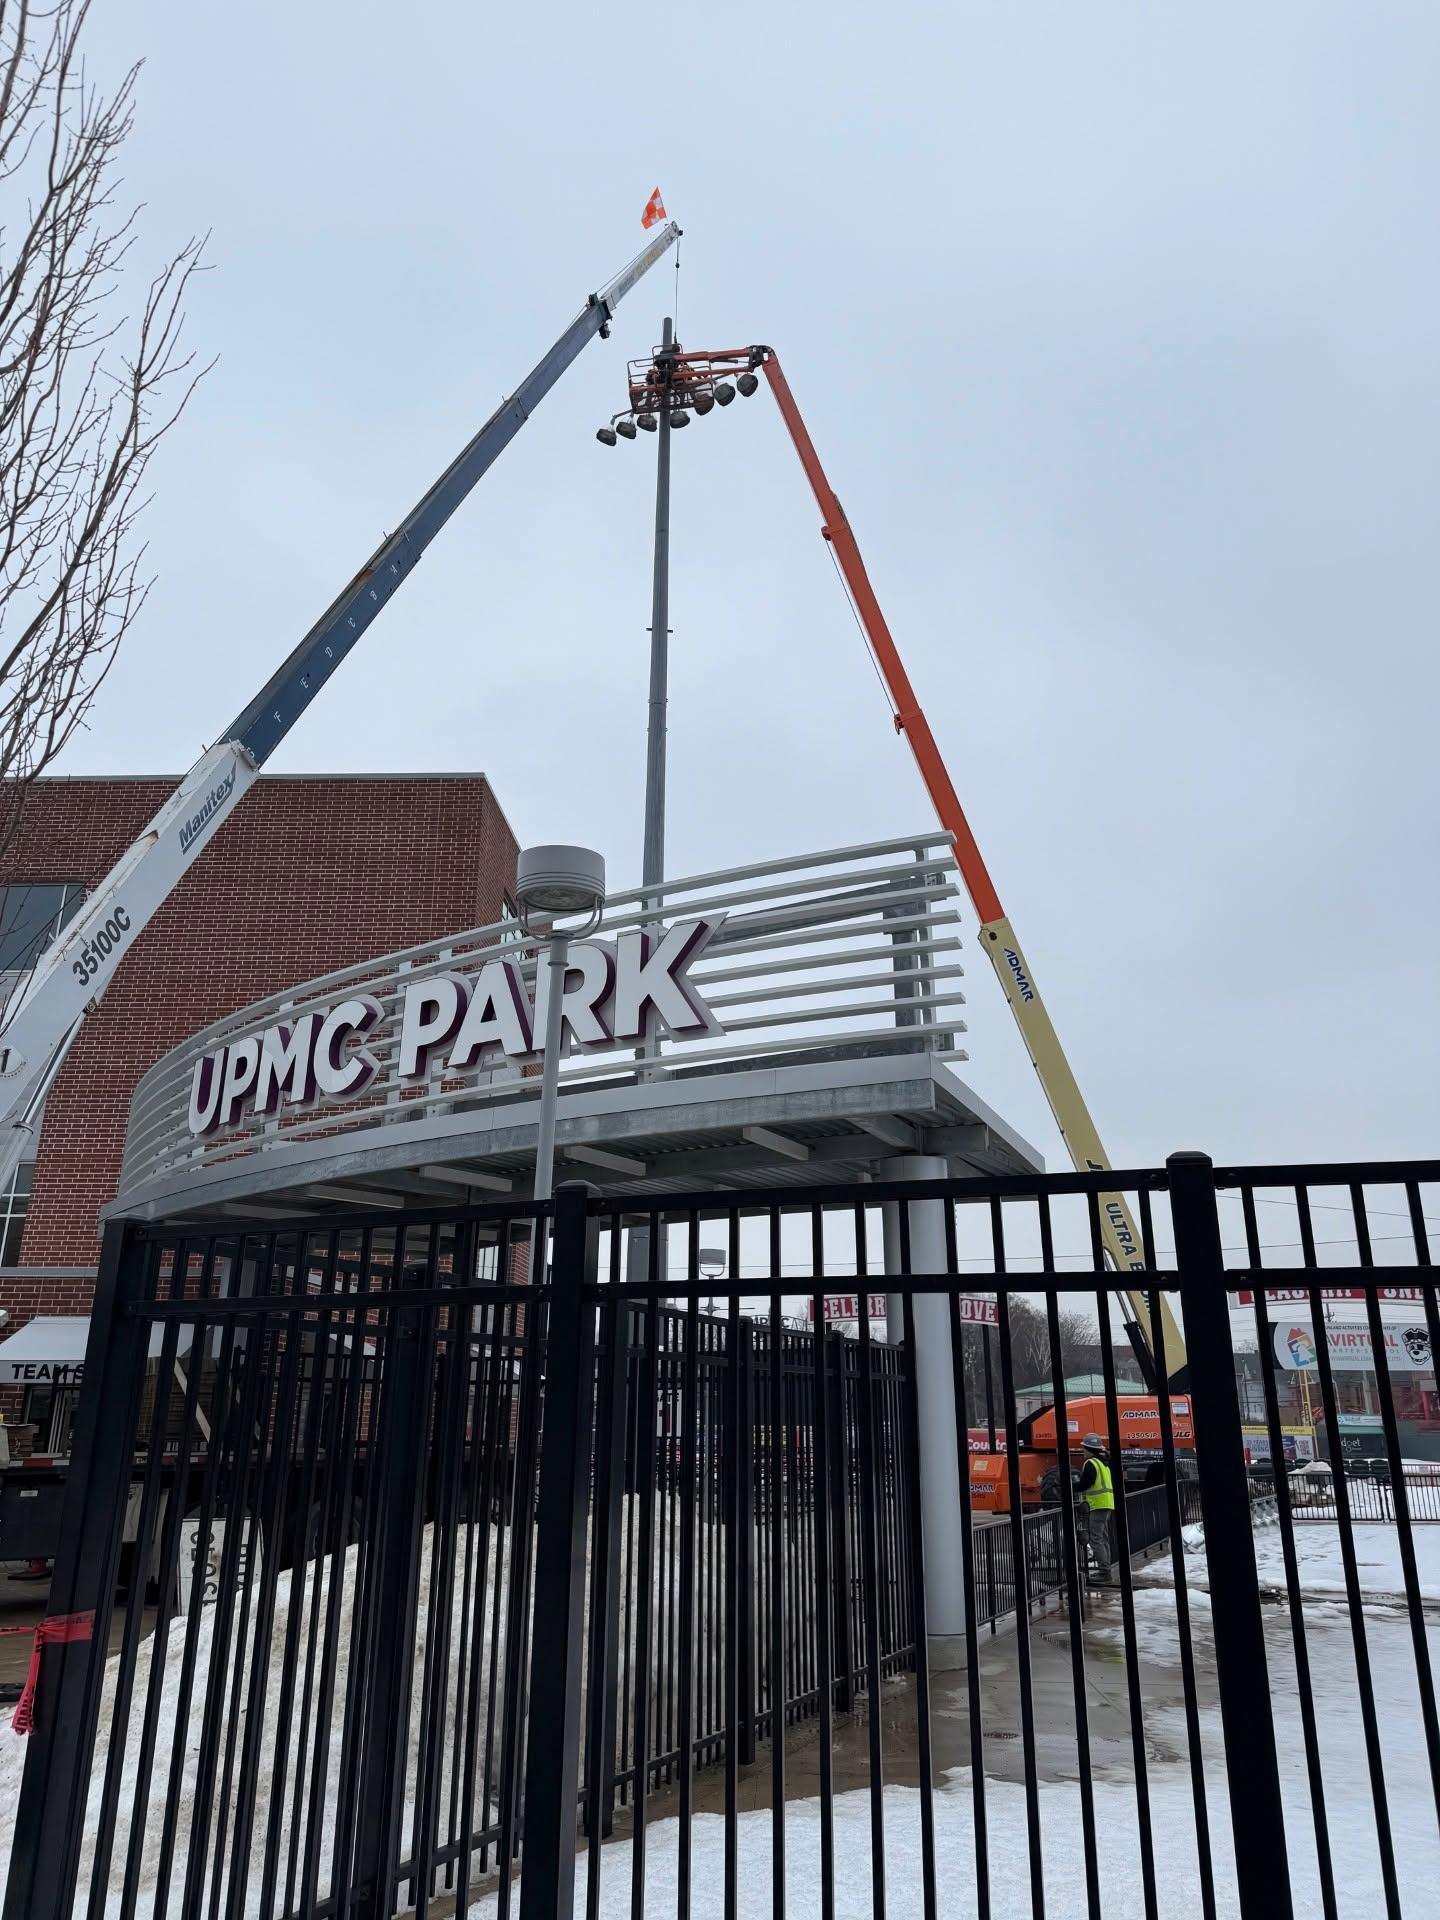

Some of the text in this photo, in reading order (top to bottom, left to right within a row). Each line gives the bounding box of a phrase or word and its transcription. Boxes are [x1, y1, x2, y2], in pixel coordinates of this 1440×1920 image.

[178, 762, 237, 853] Manitex
[72, 906, 131, 987] 35100C
[1003, 948, 1034, 1003] ADMAR
[188, 916, 716, 1136] UPMC PARK
[1105, 1202, 1138, 1257] ULTRA
[961, 1300, 996, 1322] OVE
[11, 1363, 69, 1381] TEAM
[1121, 1410, 1158, 1420] ADMAR
[1340, 1436, 1361, 1453] dget
[970, 1484, 994, 1492] DMAR
